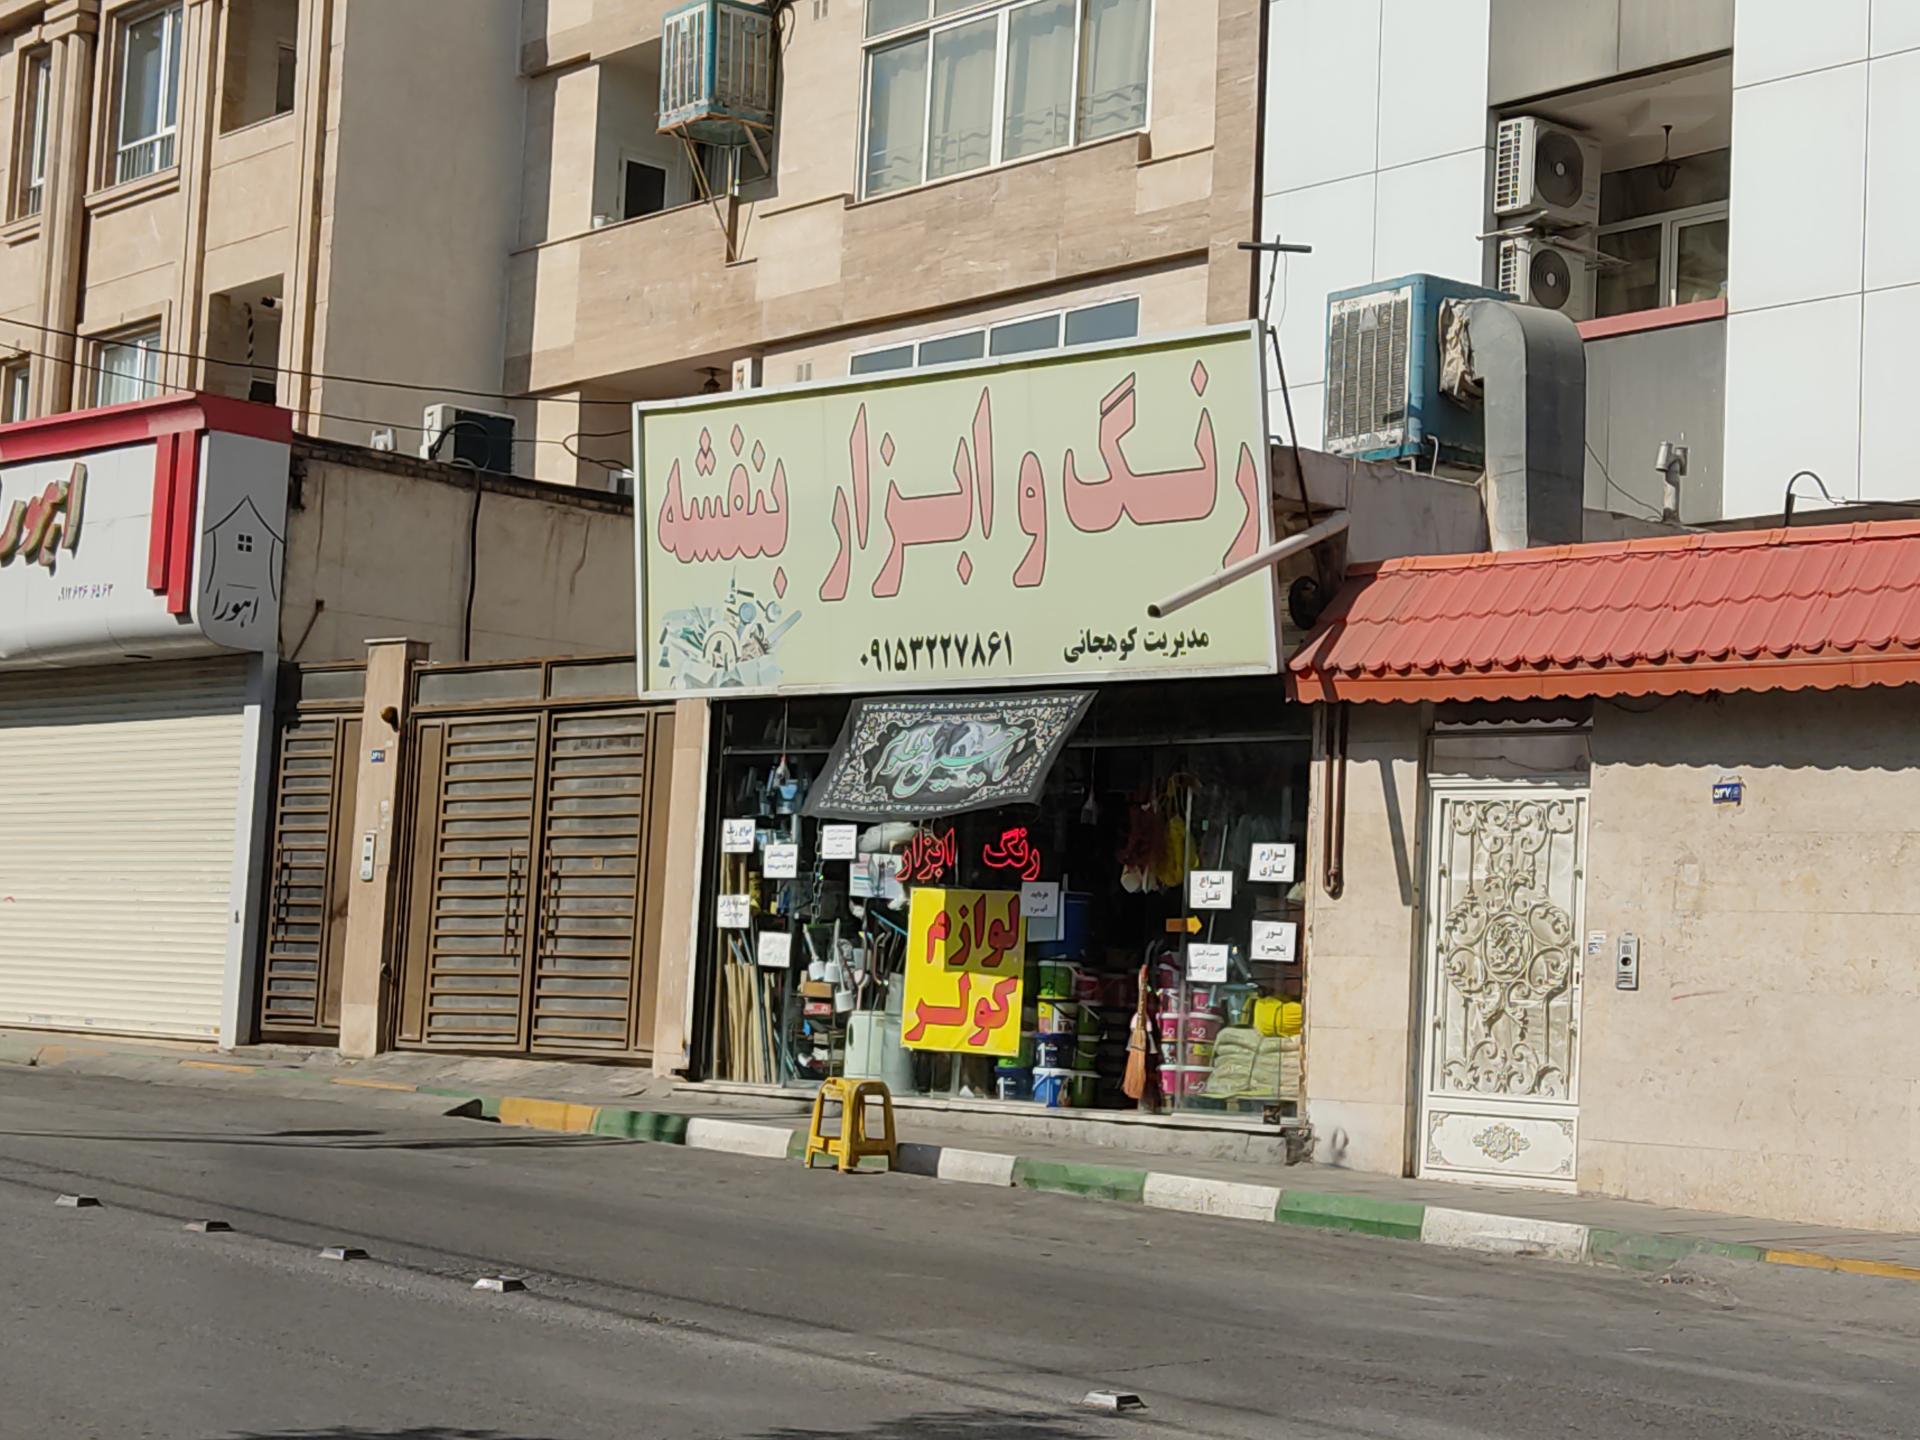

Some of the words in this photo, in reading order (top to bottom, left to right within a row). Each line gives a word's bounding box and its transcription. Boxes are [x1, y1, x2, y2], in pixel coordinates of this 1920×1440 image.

[819, 386, 994, 601] ابزار
[1062, 360, 1261, 569] رنگ
[0, 461, 87, 567] اهور
[657, 424, 789, 599] بنفشه
[1013, 451, 1047, 588] و
[859, 630, 1013, 673] ۰۹۱۵۳۲۲۷۸۶۱
[1064, 626, 1138, 664] کوهجانی
[1144, 627, 1210, 658] مدیریت
[895, 827, 956, 881] ابزار
[983, 827, 1041, 881] رنگ
[926, 893, 1021, 968] لوازم
[904, 970, 1019, 1046] کولر
